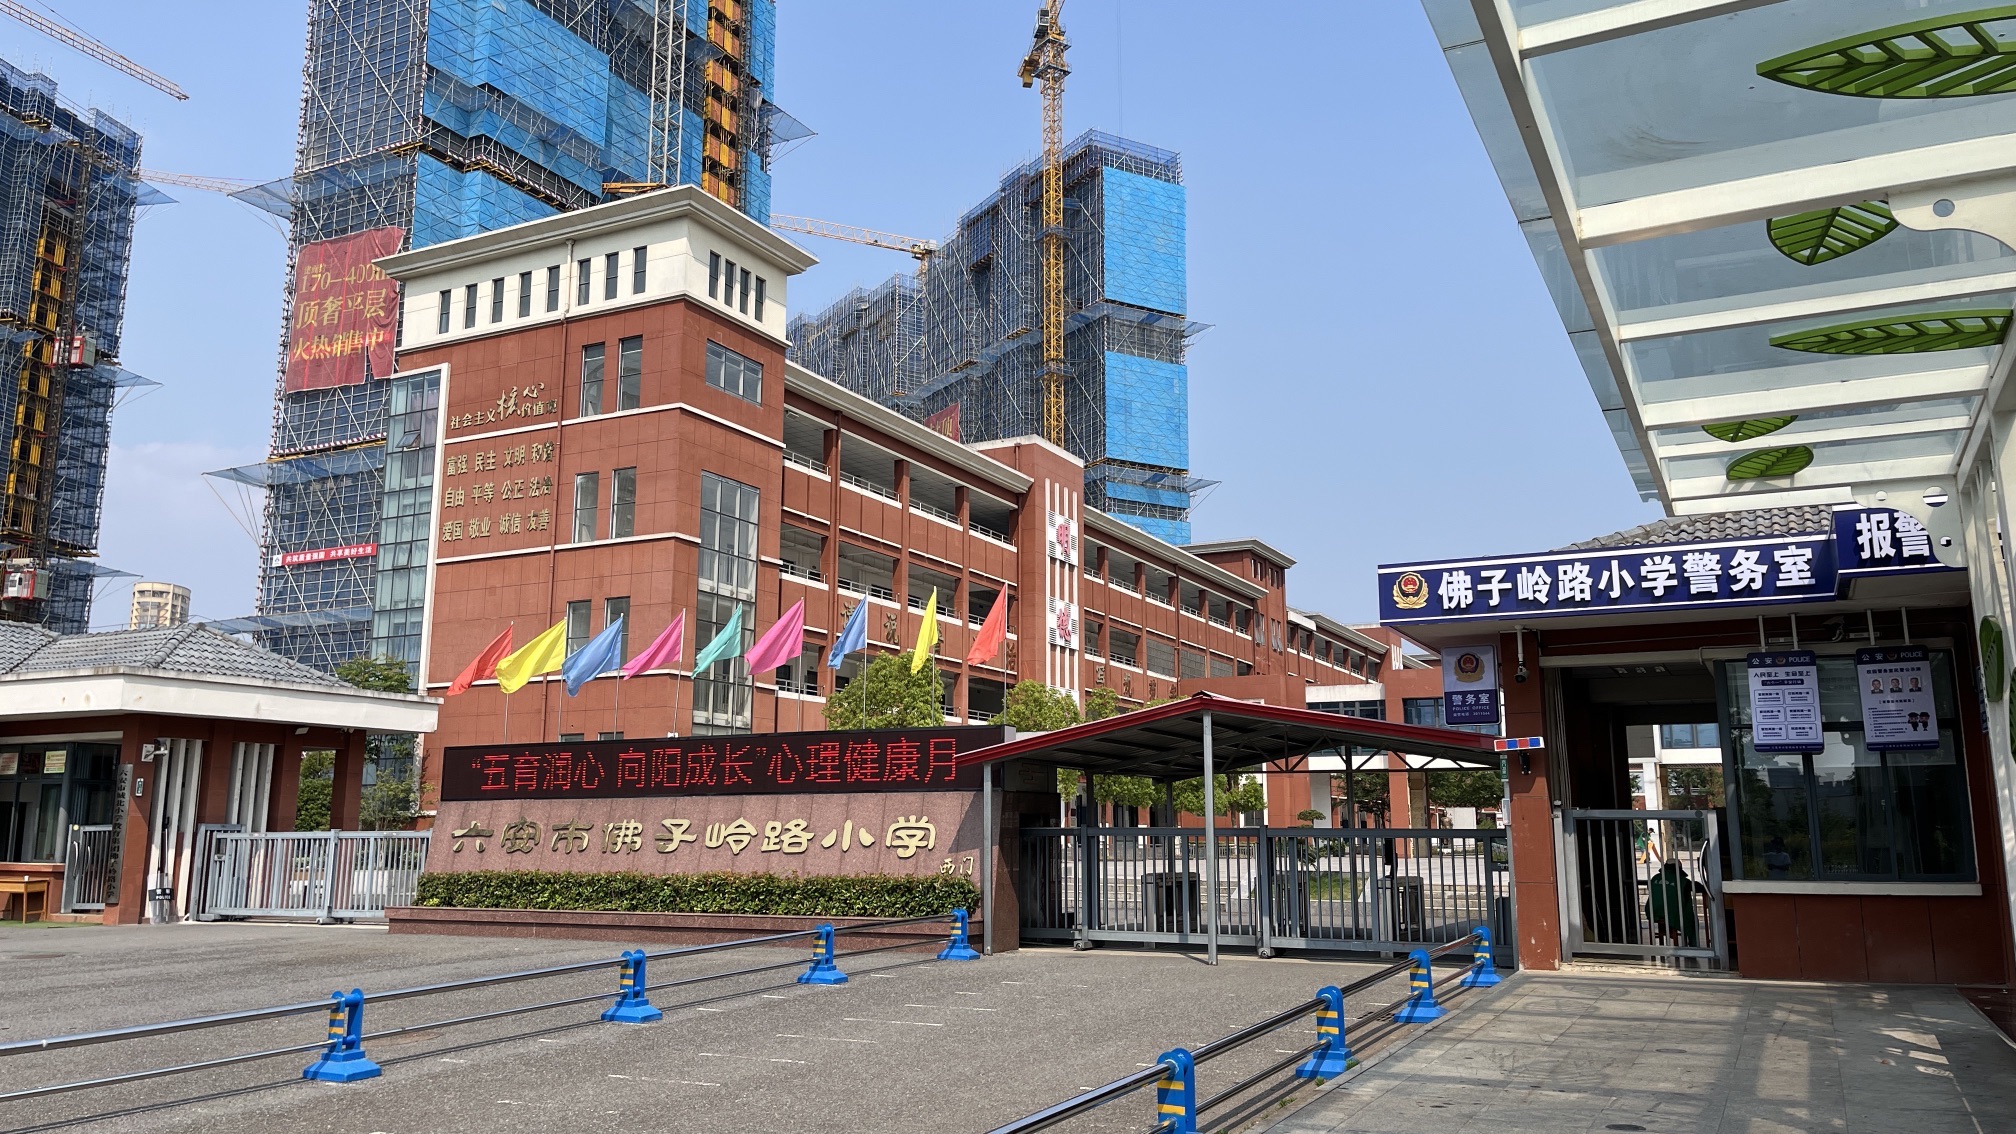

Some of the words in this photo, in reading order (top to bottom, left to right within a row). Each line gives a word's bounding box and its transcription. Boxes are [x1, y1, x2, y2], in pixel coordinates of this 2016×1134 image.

[296, 288, 387, 329] 顶奢平层
[293, 327, 385, 362] 火热销售中
[446, 453, 469, 477] 富强
[474, 449, 497, 473] 民主
[502, 444, 526, 468] 文明
[530, 440, 554, 464] 和谐
[444, 486, 465, 509] 自由
[470, 482, 495, 505] 平等
[500, 478, 525, 502] 公正
[528, 475, 554, 498] 法治
[442, 519, 464, 543] 爱国
[468, 516, 492, 540] 敬业
[498, 512, 522, 535] 诚信
[526, 508, 551, 532] 友善
[1438, 544, 1815, 610] 佛子岭路小学警务室
[1788, 655, 1811, 663] POLICE
[1900, 650, 1924, 658] POLICE
[1452, 693, 1490, 705] 警务室
[451, 815, 937, 858] 六安市佛子岭路小学
[939, 856, 975, 876] 西门
